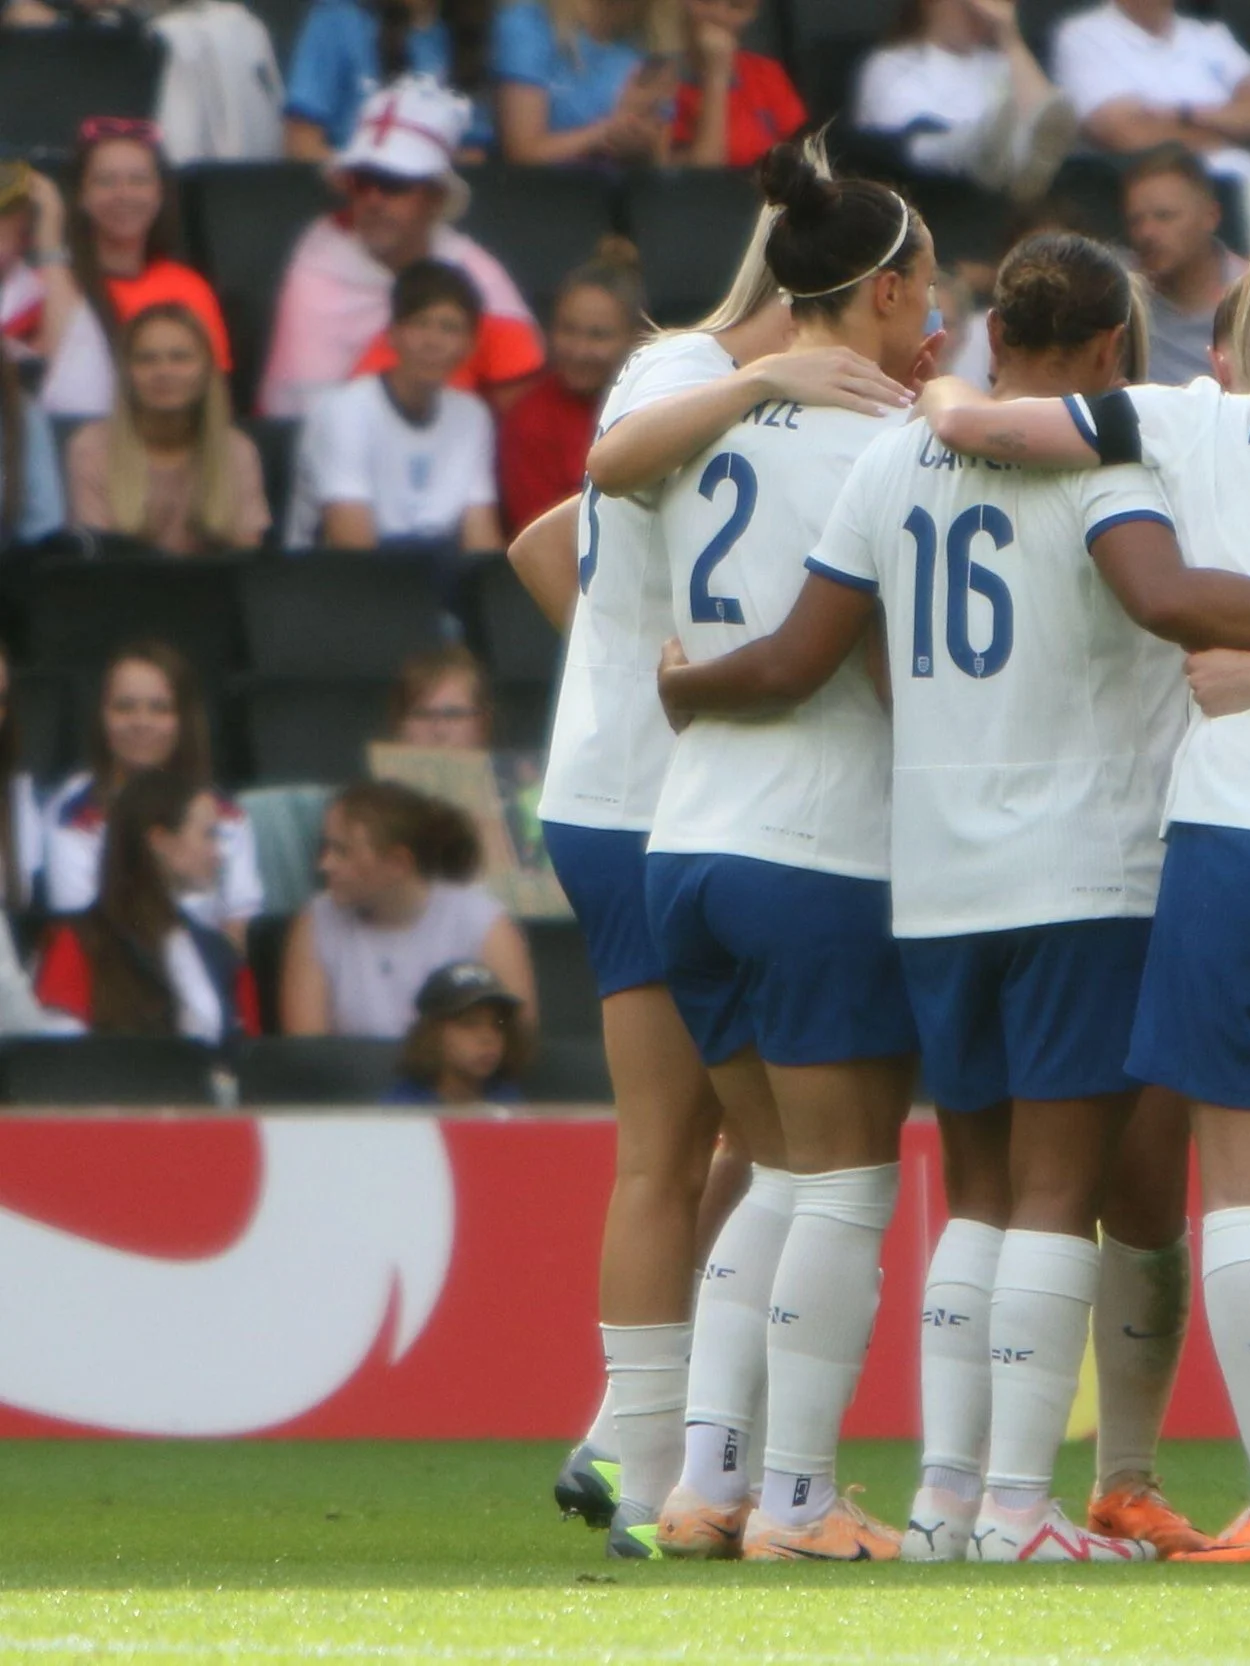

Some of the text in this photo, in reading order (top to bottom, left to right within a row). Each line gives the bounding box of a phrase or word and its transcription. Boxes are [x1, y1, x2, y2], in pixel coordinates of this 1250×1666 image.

[741, 399, 803, 430] NZE
[689, 452, 759, 625] 2
[902, 503, 1015, 679] 16
